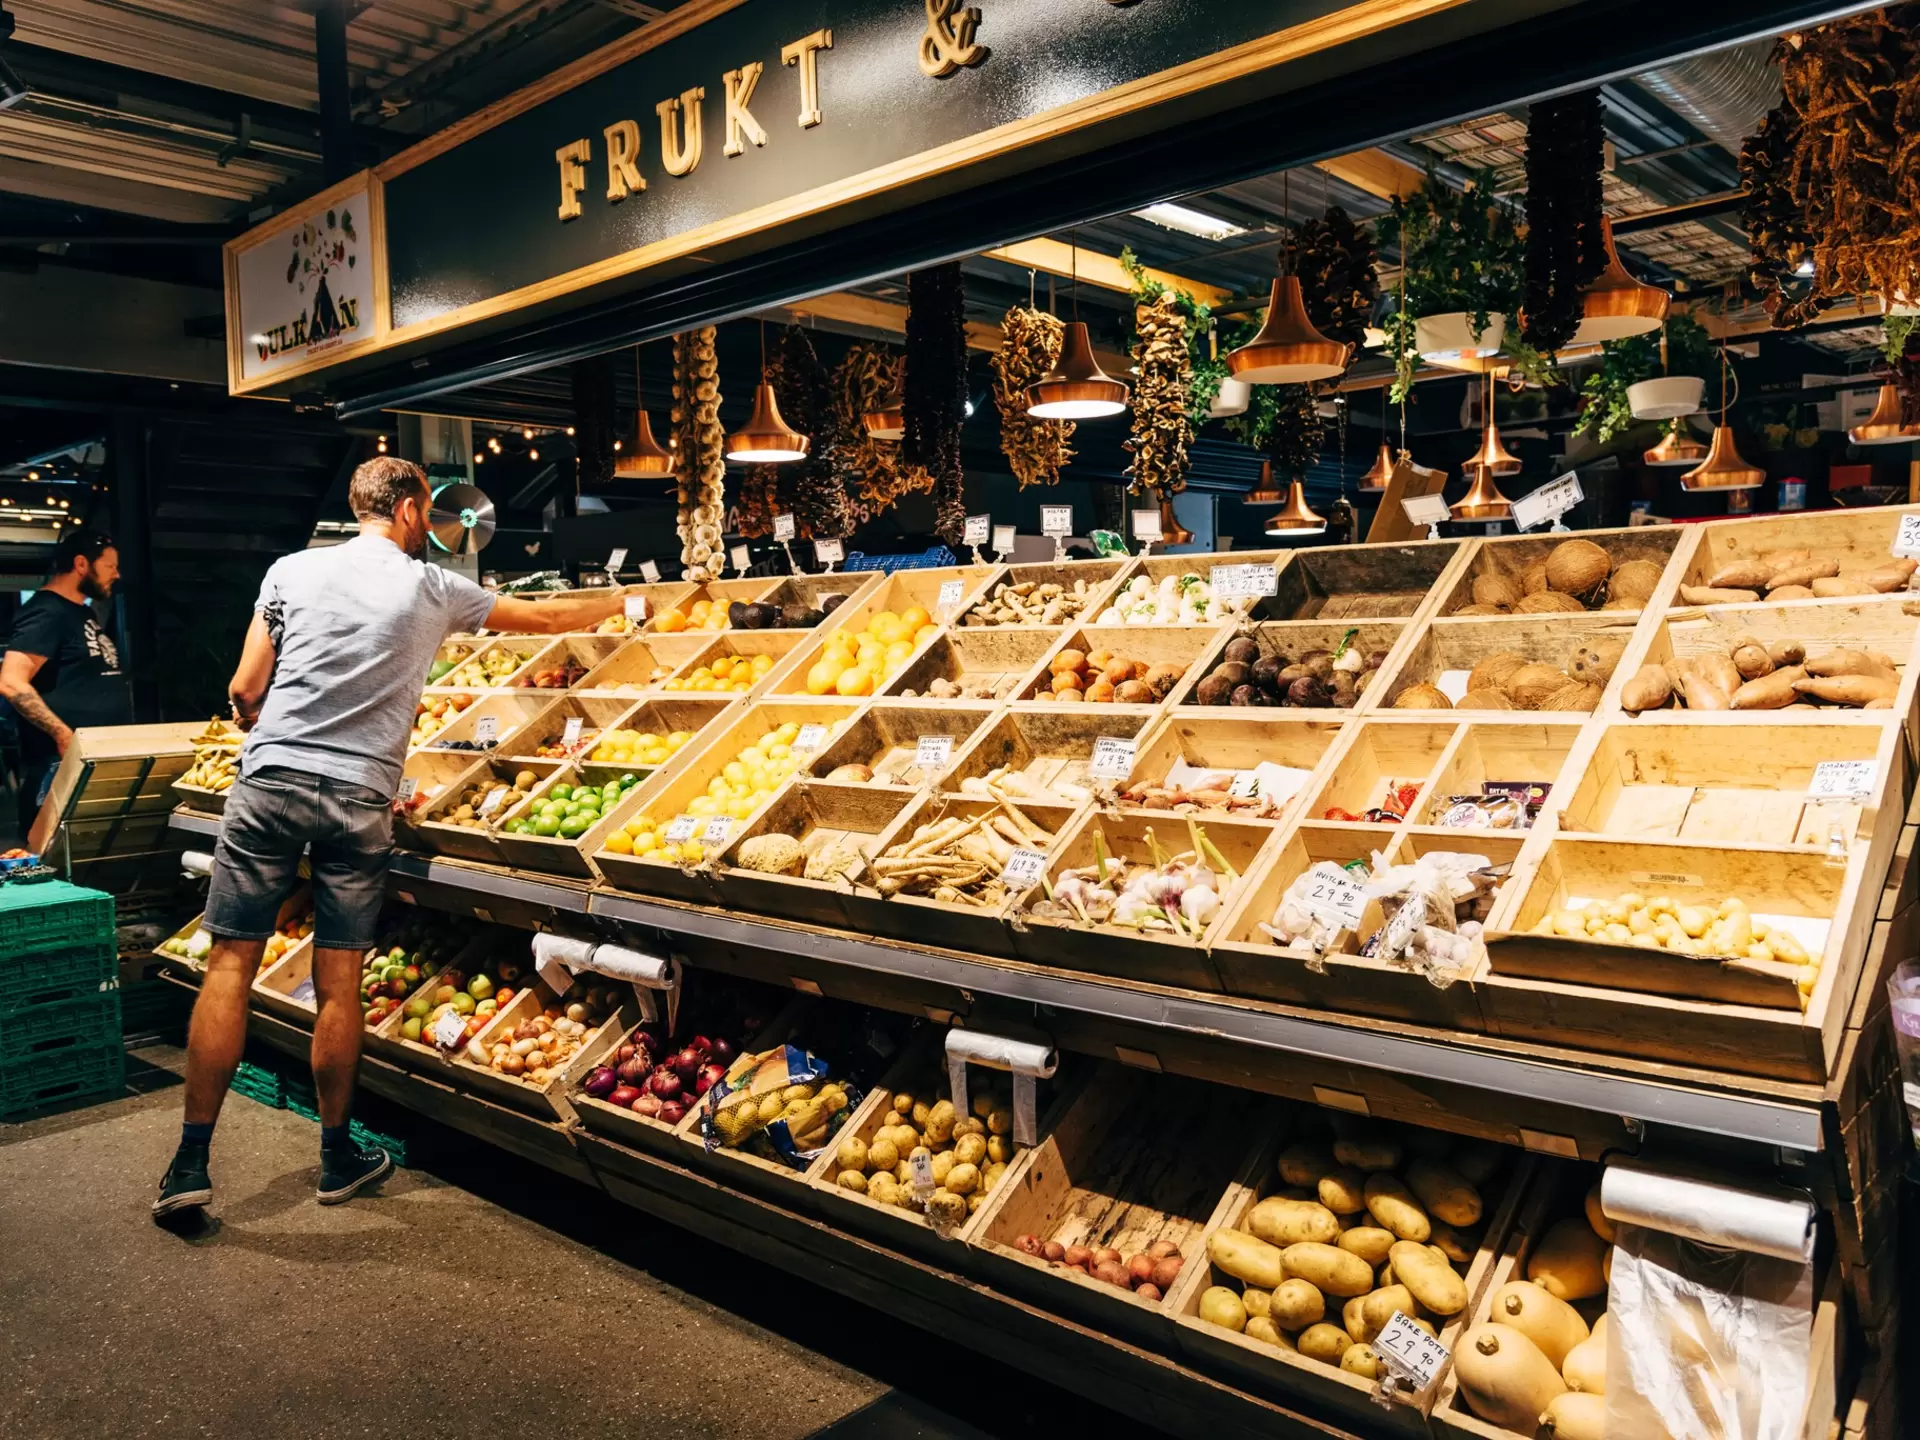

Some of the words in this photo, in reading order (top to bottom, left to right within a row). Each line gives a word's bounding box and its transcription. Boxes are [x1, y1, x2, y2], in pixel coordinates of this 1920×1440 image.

[555, 27, 834, 221] FRUKT
[1311, 884, 1336, 901] 29
[1342, 892, 1355, 902] 90
[1384, 1329, 1416, 1356] 29
[1420, 1352, 1435, 1365] 90
[1394, 1313, 1421, 1337] BAKE
[1423, 1335, 1451, 1360] POTET
